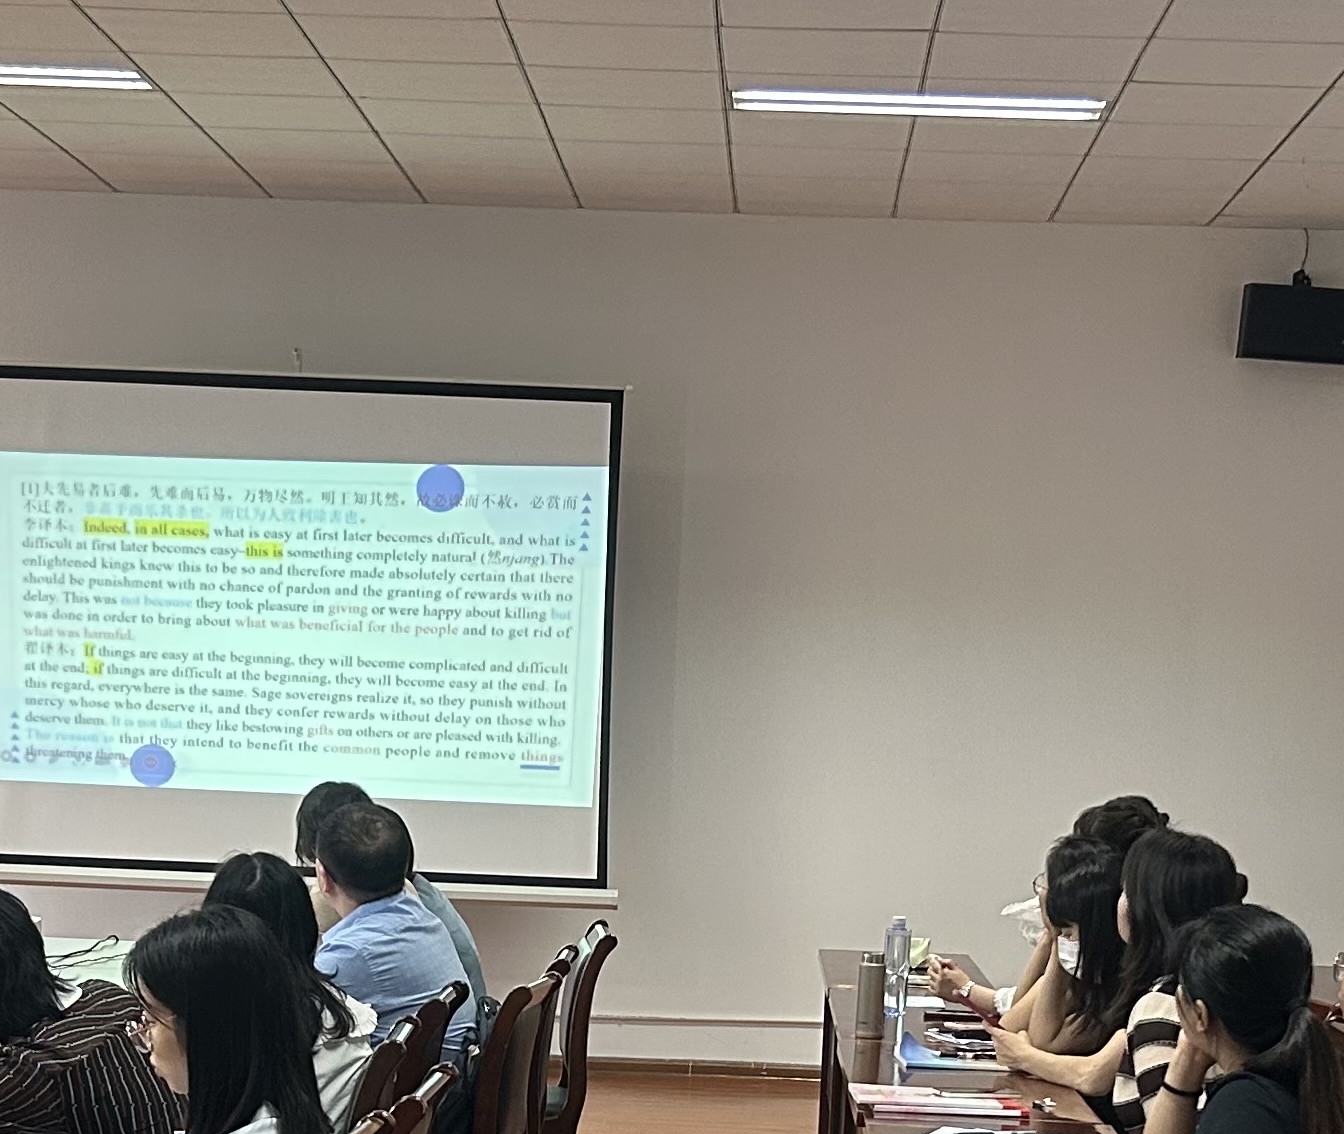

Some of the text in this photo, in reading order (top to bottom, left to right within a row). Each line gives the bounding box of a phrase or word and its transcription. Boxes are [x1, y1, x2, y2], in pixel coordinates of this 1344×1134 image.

[149, 522, 168, 535] all
[212, 525, 245, 538] what
[262, 530, 292, 542] easy
[312, 528, 339, 541] first
[342, 529, 373, 542] later
[375, 529, 433, 543] becomes
[498, 532, 523, 545] and
[527, 533, 560, 546] what
[21, 535, 72, 549] difficult
[91, 538, 116, 551] first
[120, 539, 148, 552] later
[150, 541, 206, 554] becomes
[286, 545, 353, 563] something
[355, 547, 428, 565] completely
[431, 550, 477, 563] natural
[548, 552, 575, 566] The
[21, 554, 574, 584] enlightened kings knew this and therefore made absolutely certain that there
[22, 571, 551, 602] should punishment with chance pardon and the granting rewards with
[63, 591, 89, 603] This
[92, 596, 117, 604] was
[195, 596, 222, 612] they
[225, 597, 253, 610] took
[257, 598, 308, 615] pleasure
[327, 601, 368, 617] giving
[388, 607, 419, 616] were
[422, 604, 462, 620] happy
[464, 605, 501, 618] about
[503, 606, 547, 623] killing
[22, 608, 553, 640] was done order bring about what was beneficial for the people and get rid
[39, 660, 59, 672] the
[106, 663, 145, 679] things
[148, 668, 168, 677] are
[171, 665, 221, 679] difficult
[241, 668, 260, 681] the
[334, 672, 362, 688] they
[365, 673, 391, 686] will
[395, 674, 445, 688] become
[448, 680, 478, 692] easy
[497, 678, 517, 690] the
[98, 645, 136, 661] things
[138, 650, 158, 659] are
[160, 651, 188, 663] easy
[207, 649, 226, 662] the
[298, 653, 325, 669] they
[328, 654, 353, 667] will
[356, 655, 405, 669] become
[408, 657, 486, 675] complicated
[489, 660, 513, 673] and
[516, 661, 568, 674] difficult
[24, 676, 47, 688] this
[96, 680, 170, 697] everywhere
[188, 683, 208, 696] the
[251, 686, 282, 702] Sage
[285, 688, 352, 705] sovereigns
[356, 690, 399, 704] realize
[438, 693, 466, 709] they
[469, 695, 513, 711] punish
[516, 696, 567, 710] without
[24, 695, 566, 727] mercy whose who deserve and they confer rewards without delay those who
[24, 710, 71, 724] deserve
[186, 718, 212, 733] they
[215, 719, 238, 731] like
[241, 720, 303, 737] bestowing
[307, 723, 333, 738] gifts
[355, 725, 393, 738] others
[412, 731, 432, 740] are
[435, 728, 481, 745] pleased
[485, 730, 513, 743] with
[118, 732, 564, 765] that they intend benefit the common people and remove things
